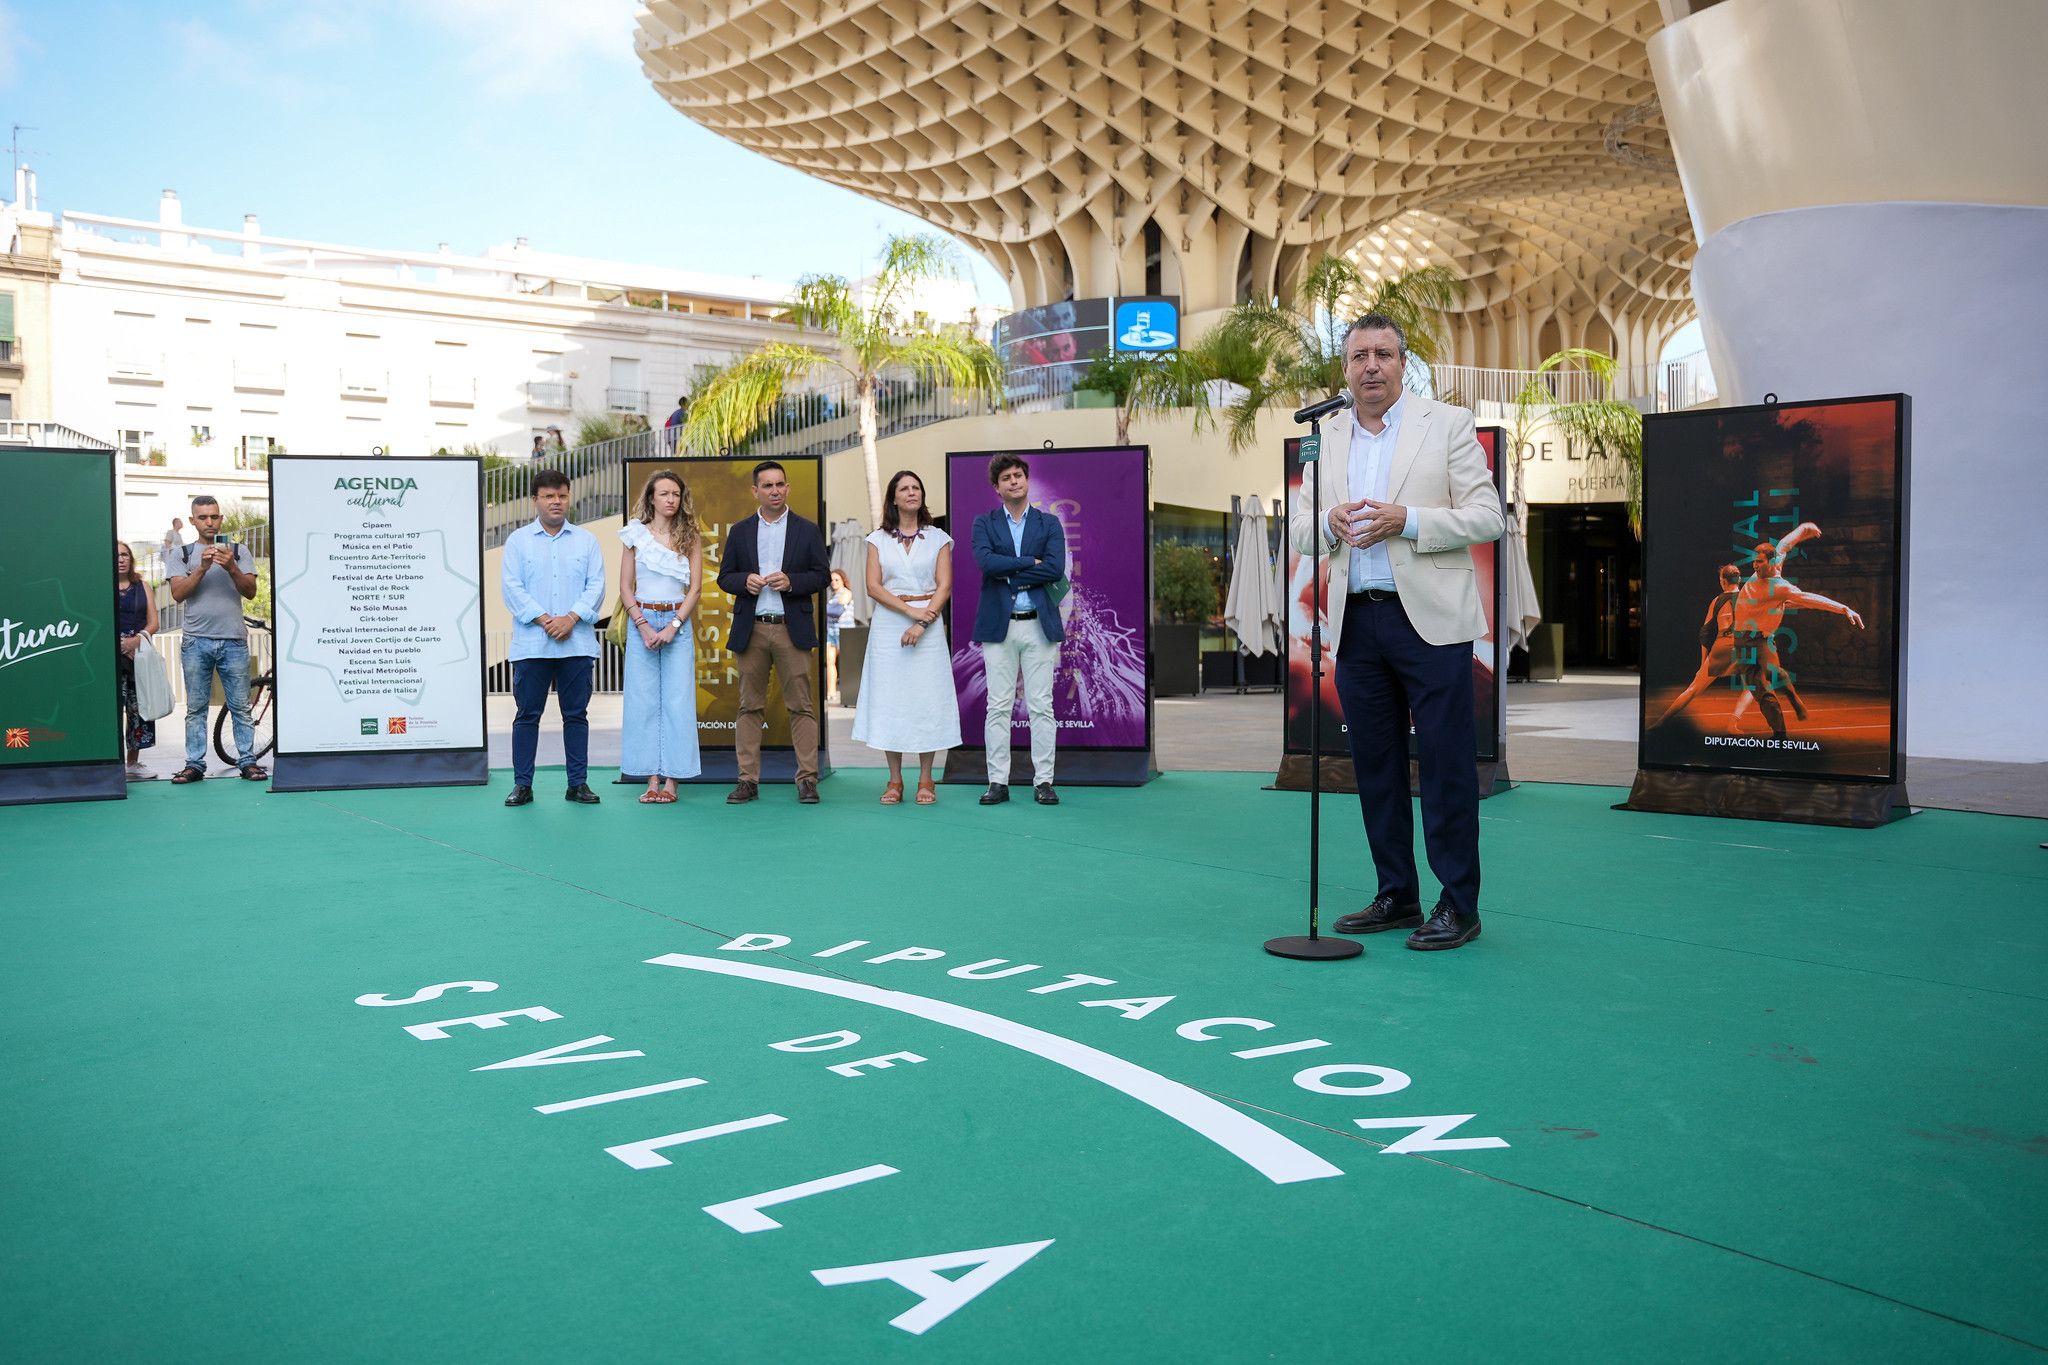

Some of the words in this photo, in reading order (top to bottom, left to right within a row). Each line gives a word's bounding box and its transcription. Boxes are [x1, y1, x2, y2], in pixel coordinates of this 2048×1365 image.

[1520, 442, 1553, 461] DE
[1567, 437, 1608, 461] LA
[334, 477, 418, 490] AGENDA
[1568, 476, 1625, 490] PUERTA
[347, 488, 406, 508] cultural
[362, 521, 392, 530] Cipaem
[334, 532, 372, 541] Programa
[393, 542, 413, 550] Patio
[333, 574, 362, 582] Festival
[395, 573, 424, 581] Urbano
[347, 584, 377, 592] Festival
[1731, 489, 1759, 691] FESTIVAL
[389, 593, 405, 601] SUR
[383, 604, 407, 612] Musas
[698, 523, 720, 685] FESTIVAL
[322, 626, 352, 634] Festival
[355, 625, 406, 633] Internacional
[408, 625, 417, 633] de
[0, 618, 80, 660] tura
[318, 637, 348, 645] Festival
[375, 636, 401, 645] Cortijo
[339, 647, 371, 655] Navidad
[395, 646, 421, 655] pueblo
[349, 658, 376, 666] Escena
[344, 667, 374, 675] Festival
[339, 678, 369, 686] Festival
[371, 677, 422, 686] Internacional
[697, 720, 727, 729] TACIÓN
[1065, 720, 1095, 728] SEVILLA
[1704, 736, 1764, 748] DIPUTACIÓN
[1766, 739, 1781, 749] DE
[1782, 740, 1820, 751] SEVILLA
[768, 1030, 929, 1077] DE
[354, 980, 1055, 1335] SEVILLA
